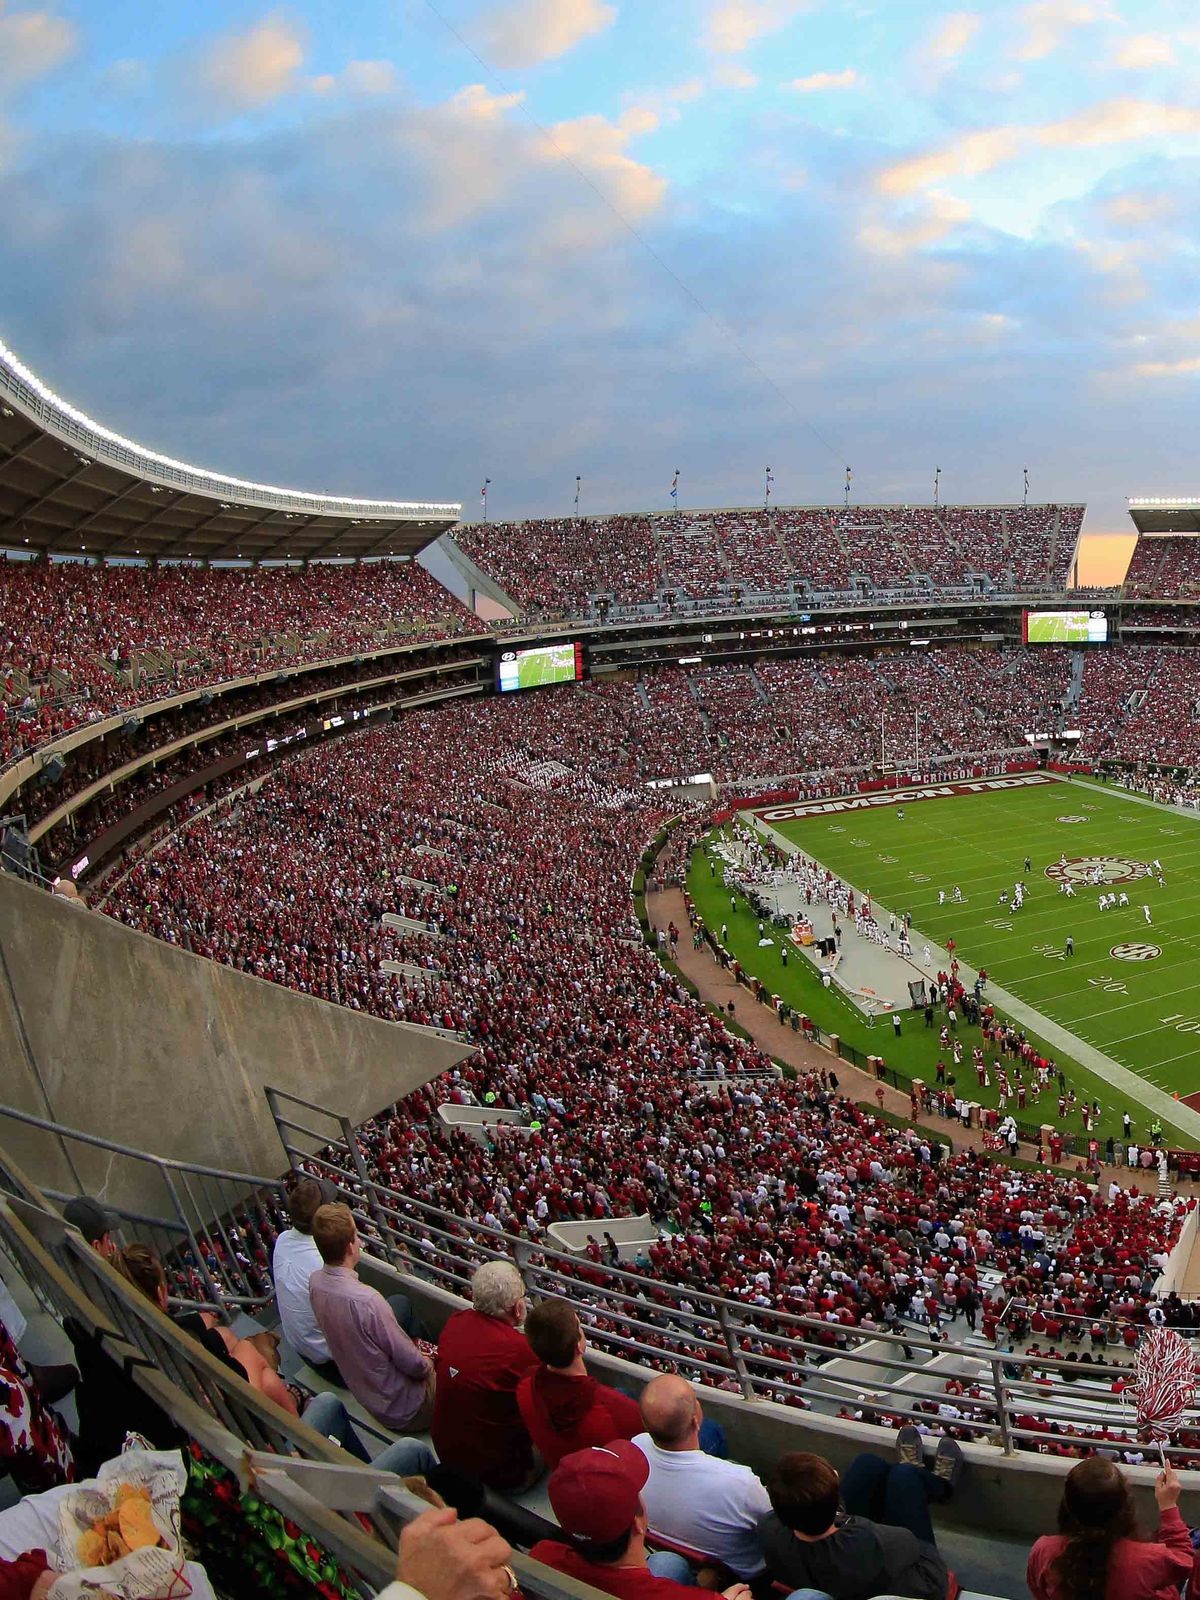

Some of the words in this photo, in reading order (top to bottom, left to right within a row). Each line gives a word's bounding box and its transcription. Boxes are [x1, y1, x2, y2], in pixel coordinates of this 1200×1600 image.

[763, 786, 955, 821] CRIMSON
[957, 775, 1052, 792] TIDE
[1031, 944, 1065, 958] 30
[1087, 975, 1127, 993] 20
